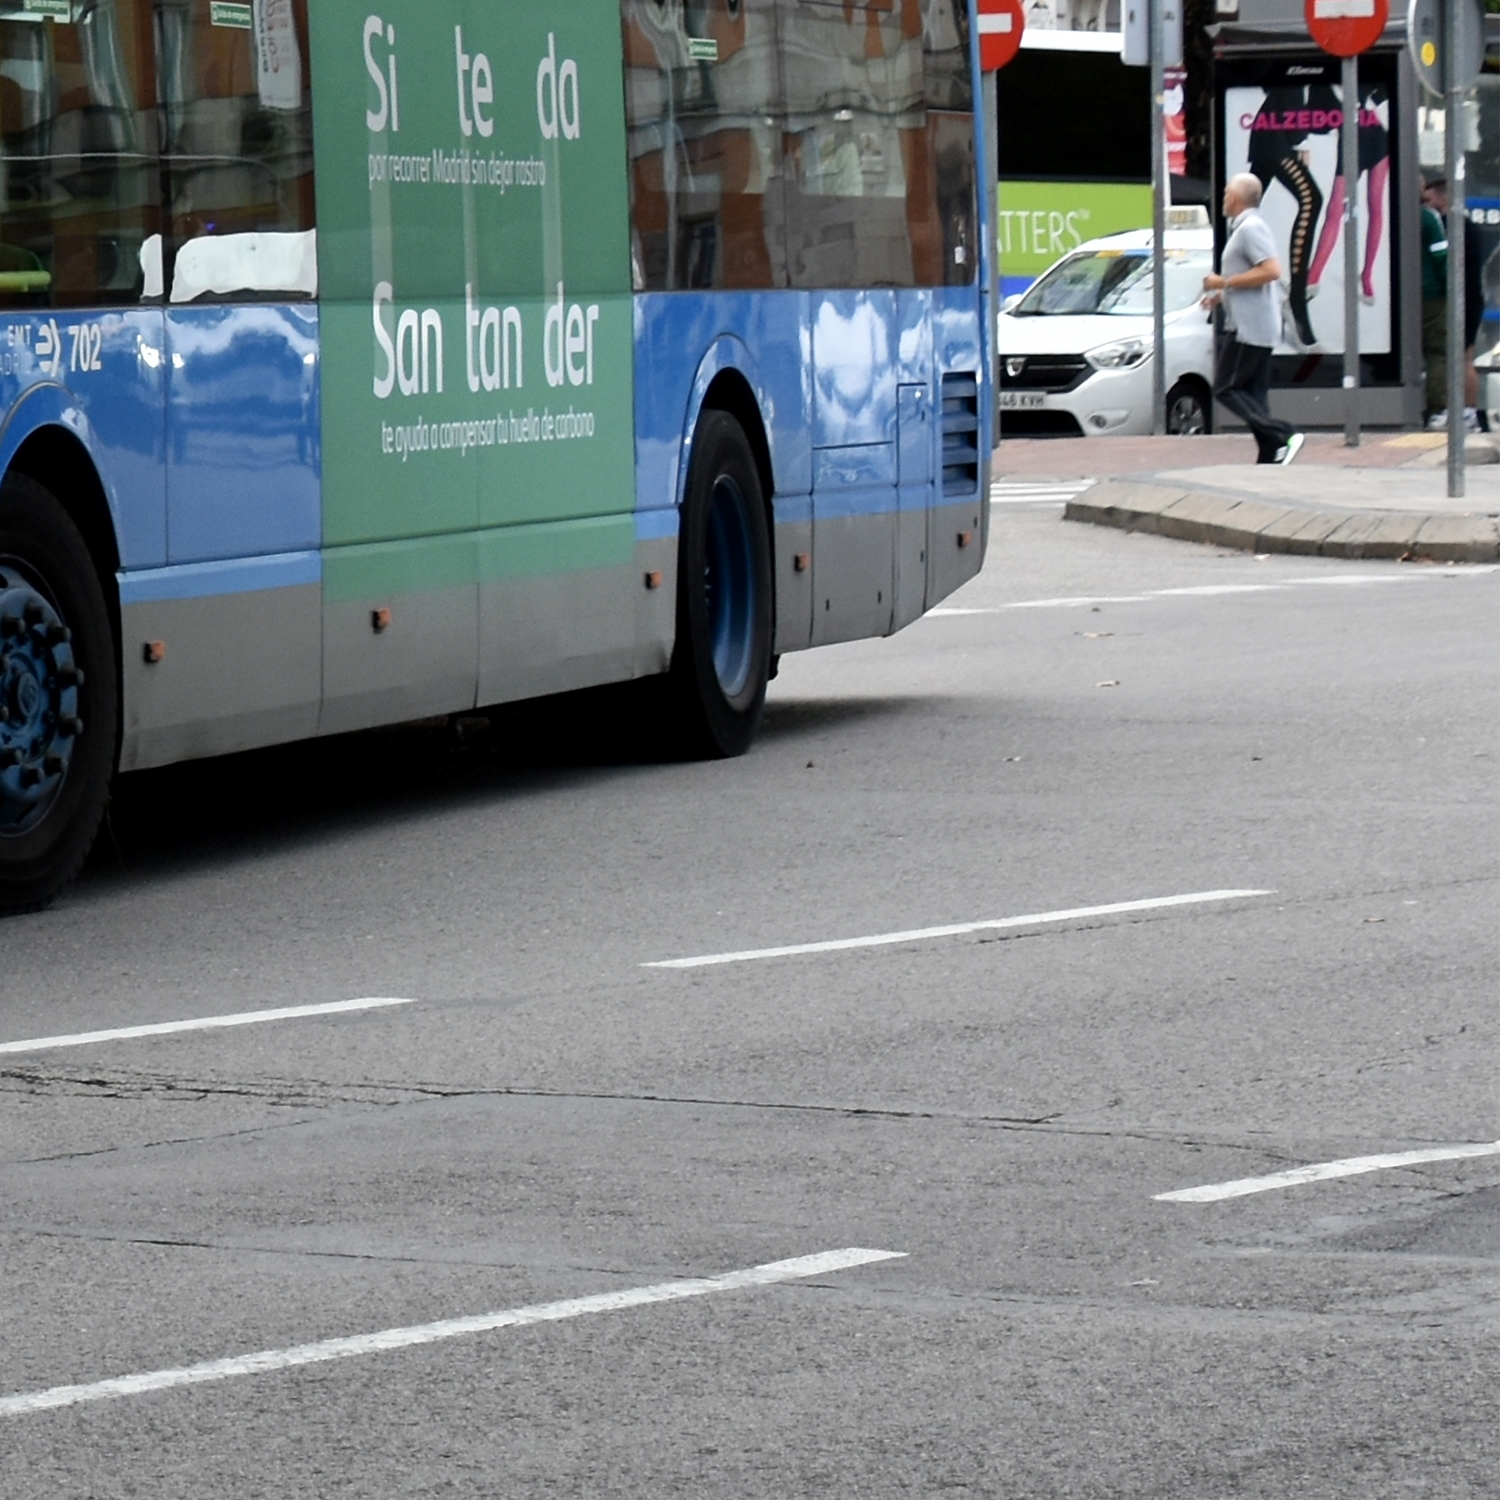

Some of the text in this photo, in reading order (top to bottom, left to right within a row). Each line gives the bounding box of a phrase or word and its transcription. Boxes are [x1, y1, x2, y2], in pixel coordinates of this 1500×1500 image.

[363, 15, 580, 140] Si te da
[1240, 108, 1380, 130] CALZEDOIA
[68, 324, 101, 372] 702
[372, 280, 599, 399] San tan der
